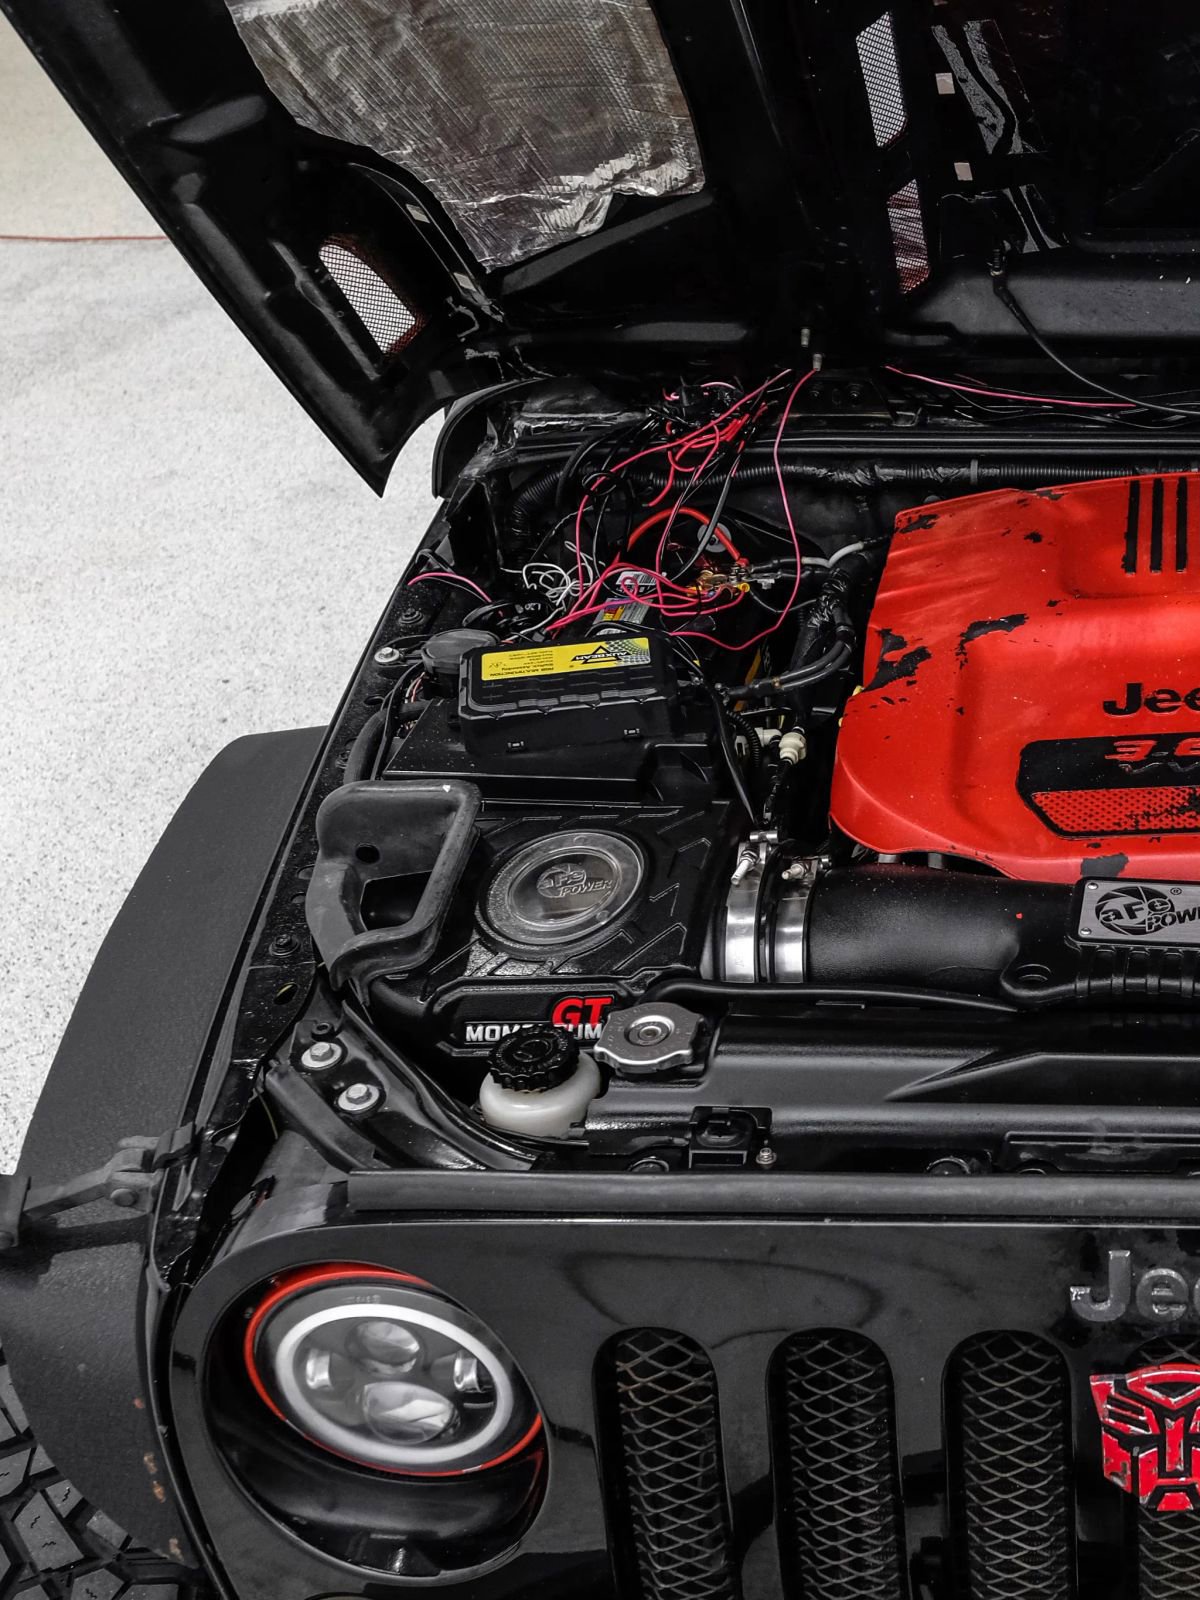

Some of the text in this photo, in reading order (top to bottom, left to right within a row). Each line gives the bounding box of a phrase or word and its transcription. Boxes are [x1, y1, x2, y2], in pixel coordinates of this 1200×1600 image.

[575, 651, 628, 661] AUXBEAM
[559, 879, 614, 898] POWER
[552, 996, 612, 1030] GT
